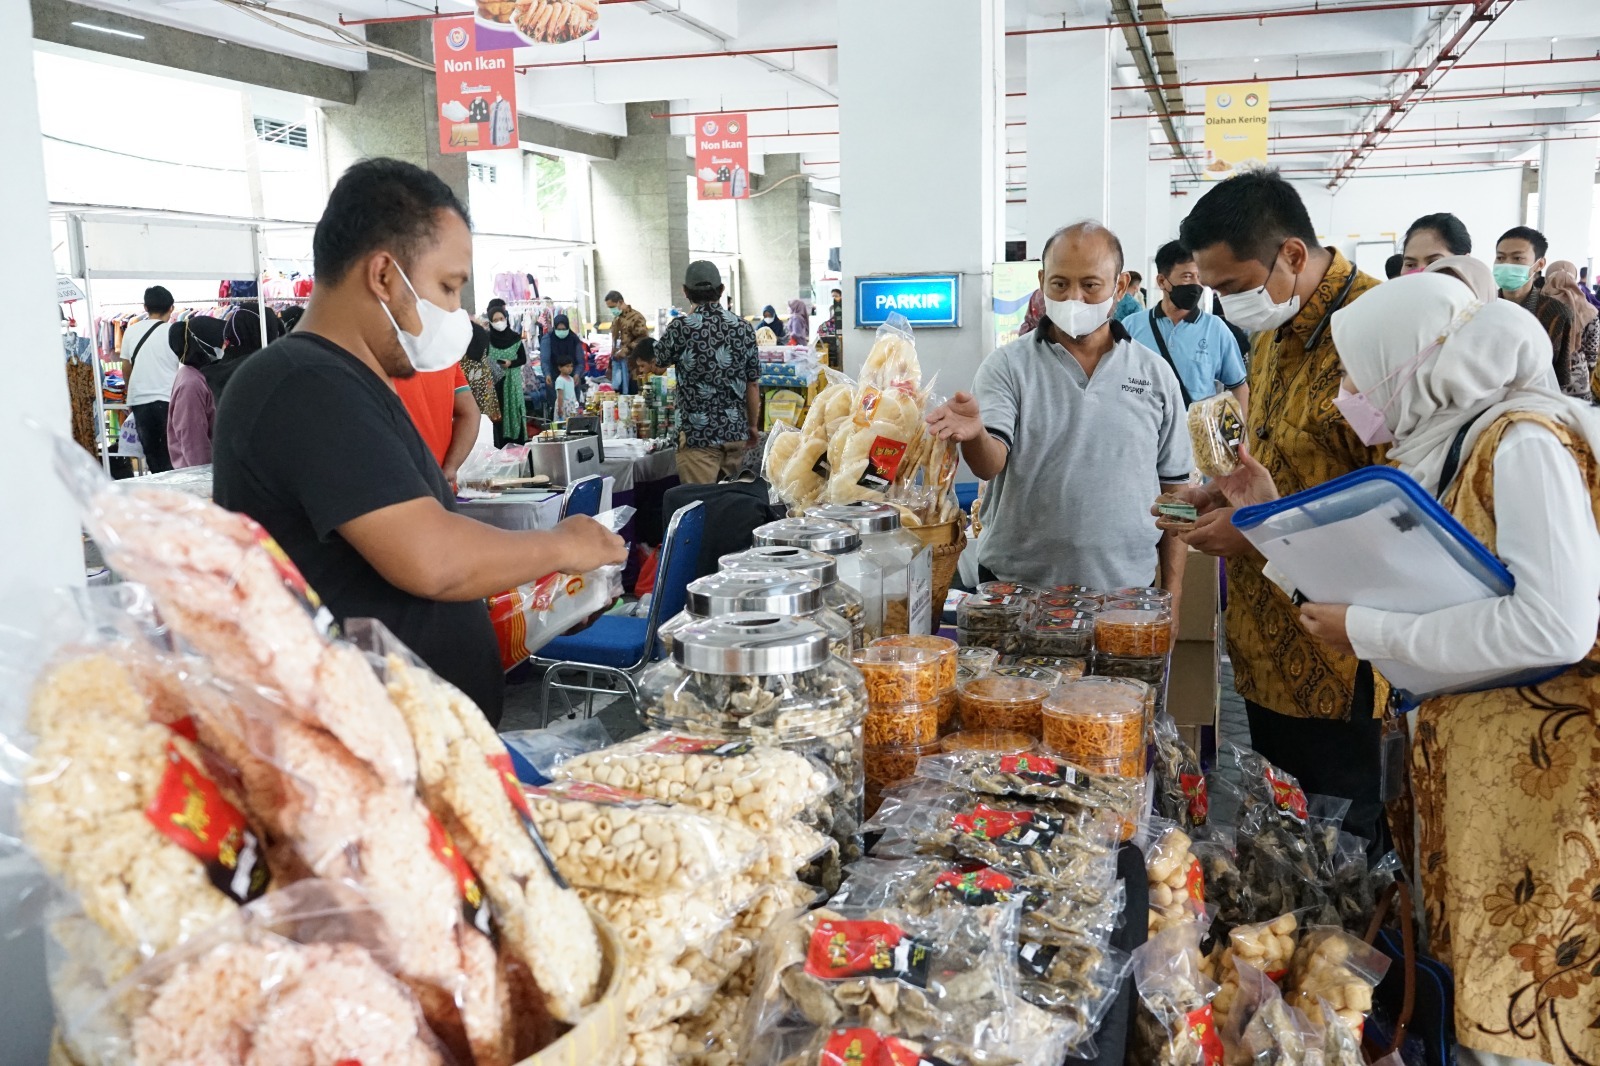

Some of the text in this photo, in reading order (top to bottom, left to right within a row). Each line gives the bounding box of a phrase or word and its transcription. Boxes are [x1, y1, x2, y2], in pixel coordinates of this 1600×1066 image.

[444, 56, 506, 73] Non Ikan
[1206, 115, 1267, 125] Olahan Kering
[701, 139, 742, 151] Non Ikan
[875, 293, 940, 309] PARKIR
